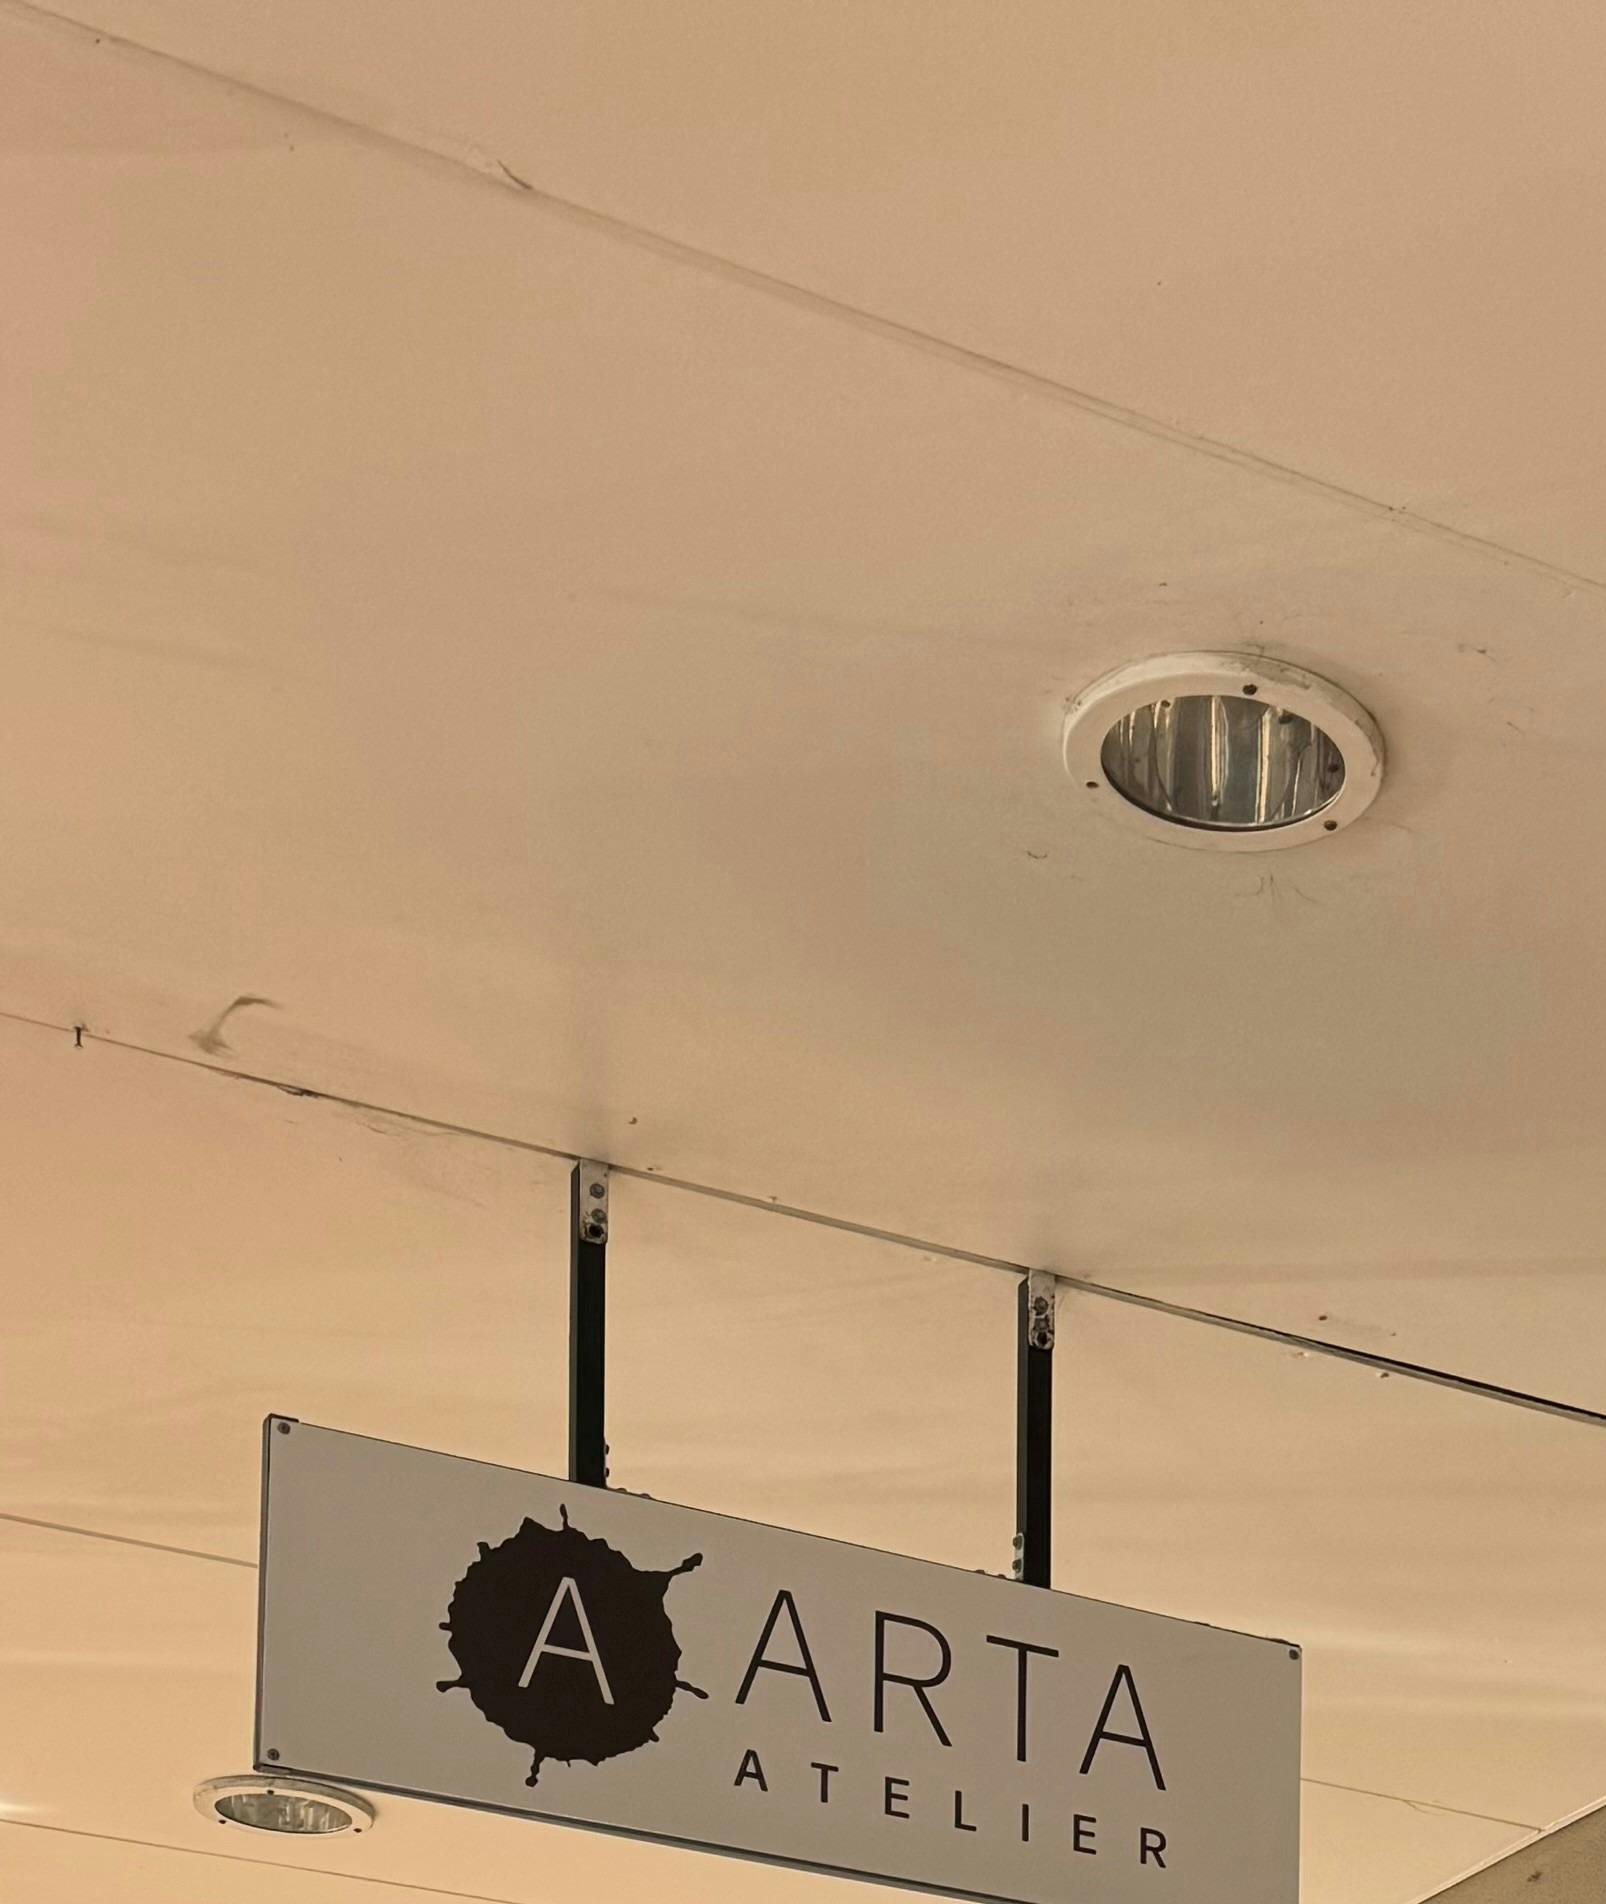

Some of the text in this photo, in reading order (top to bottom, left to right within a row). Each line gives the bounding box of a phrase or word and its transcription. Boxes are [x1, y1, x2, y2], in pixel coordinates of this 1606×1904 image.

[518, 1576, 616, 1706] A
[734, 1588, 1167, 1792] ARTA
[733, 1747, 1168, 1869] ATELIER
